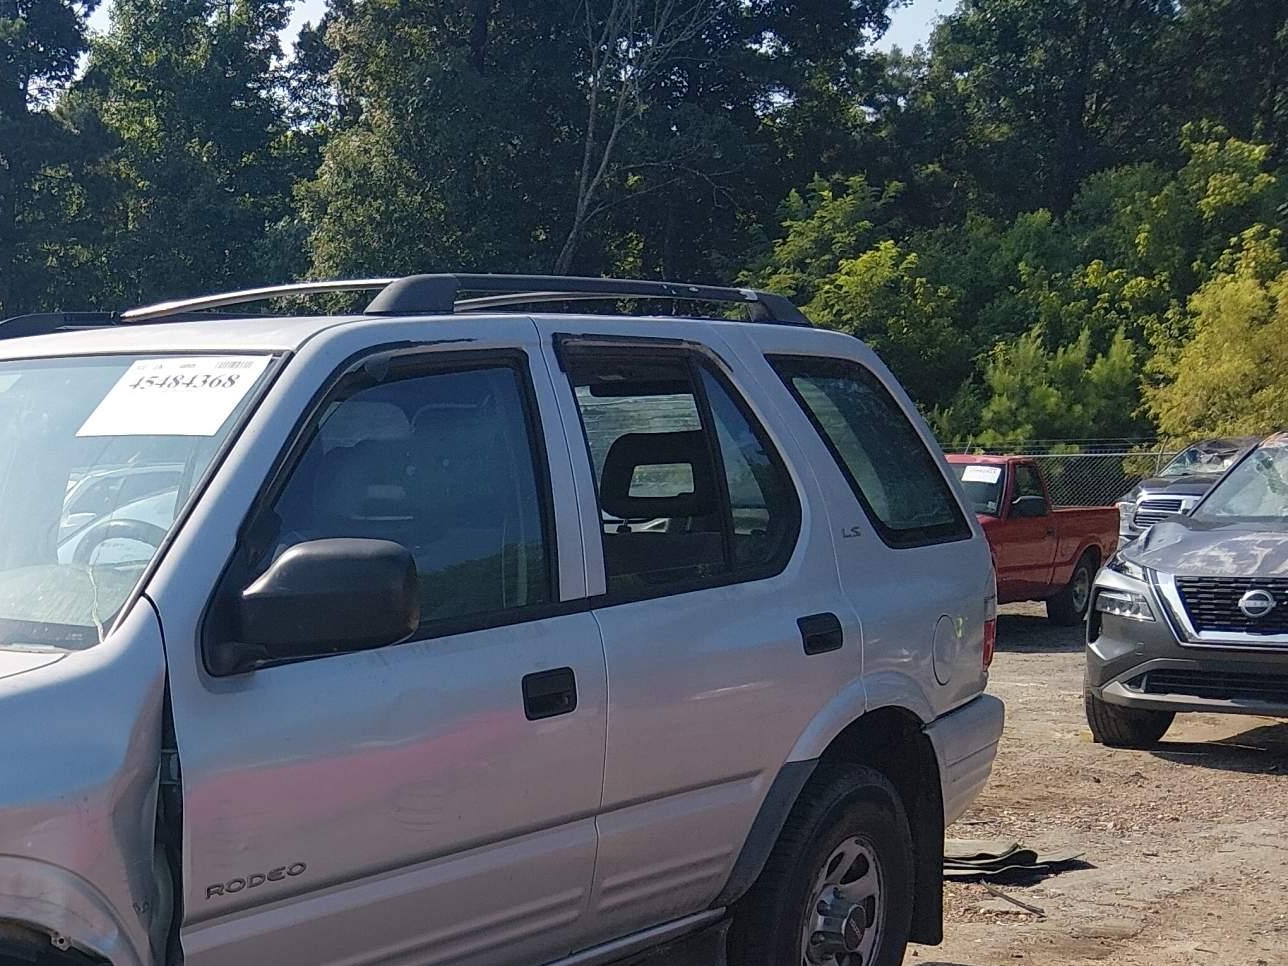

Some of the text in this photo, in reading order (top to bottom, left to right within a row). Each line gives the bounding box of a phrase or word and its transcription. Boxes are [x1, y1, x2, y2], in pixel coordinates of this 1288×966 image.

[128, 373, 242, 391] 45484368
[841, 526, 862, 539] LS
[205, 861, 308, 900] RODEO
